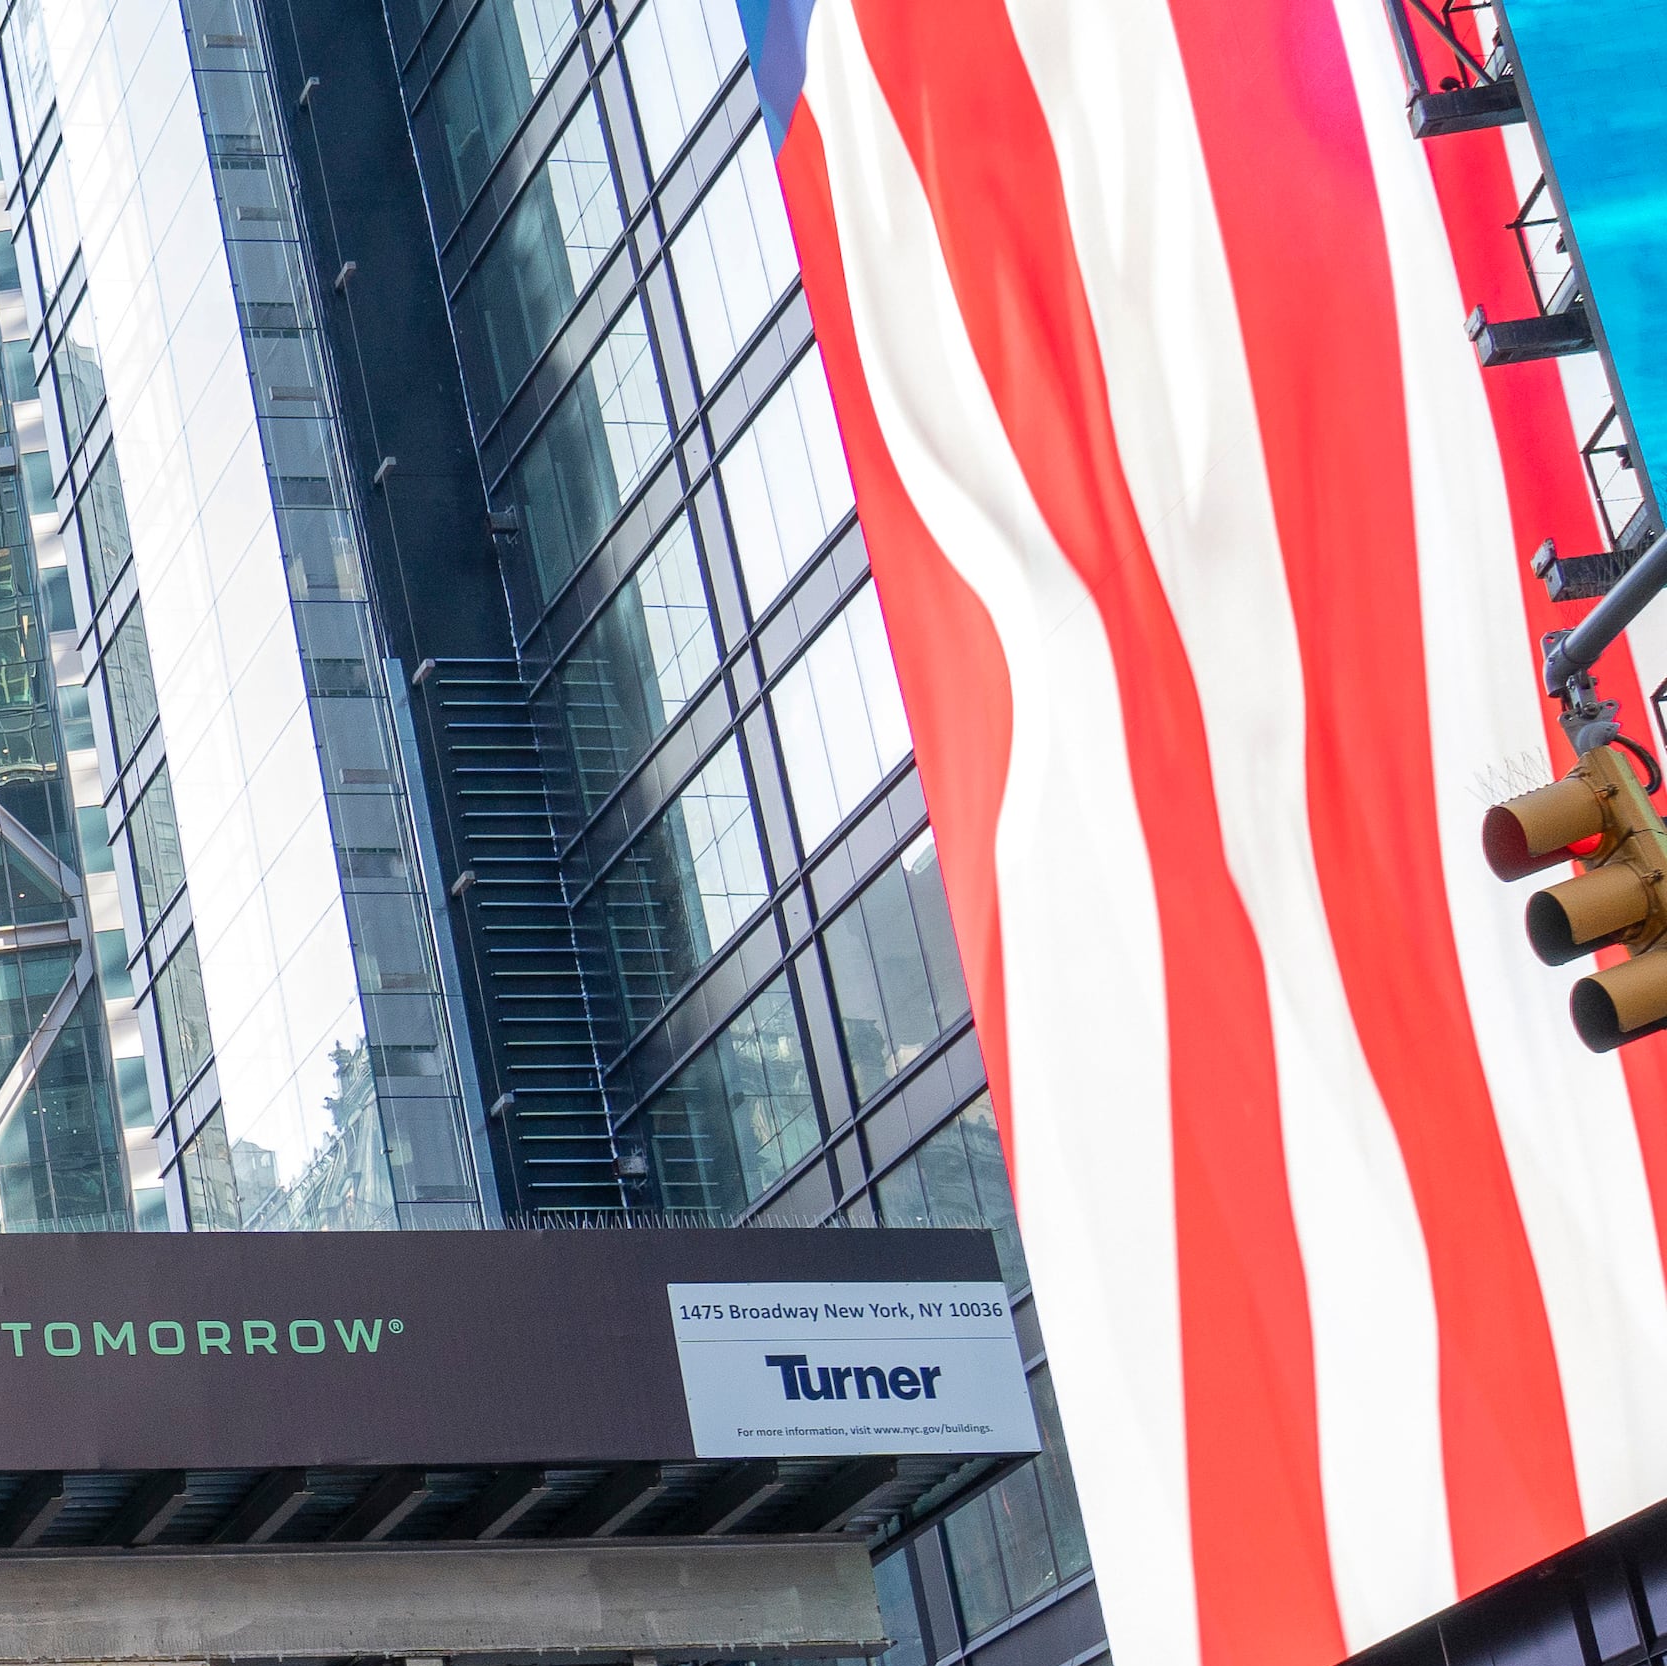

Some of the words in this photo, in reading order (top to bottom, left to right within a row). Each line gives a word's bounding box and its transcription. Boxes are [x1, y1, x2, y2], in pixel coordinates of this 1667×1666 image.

[680, 1305, 724, 1320] 1475
[730, 1304, 819, 1322] Broadway
[825, 1303, 864, 1319] New
[869, 1303, 915, 1320] York,
[920, 1302, 943, 1318] NY
[950, 1301, 1003, 1318] 10036
[764, 1354, 941, 1401] Turner
[737, 1427, 753, 1437] For
[756, 1428, 783, 1437] more
[785, 1425, 849, 1437] information,
[850, 1424, 871, 1435] visit
